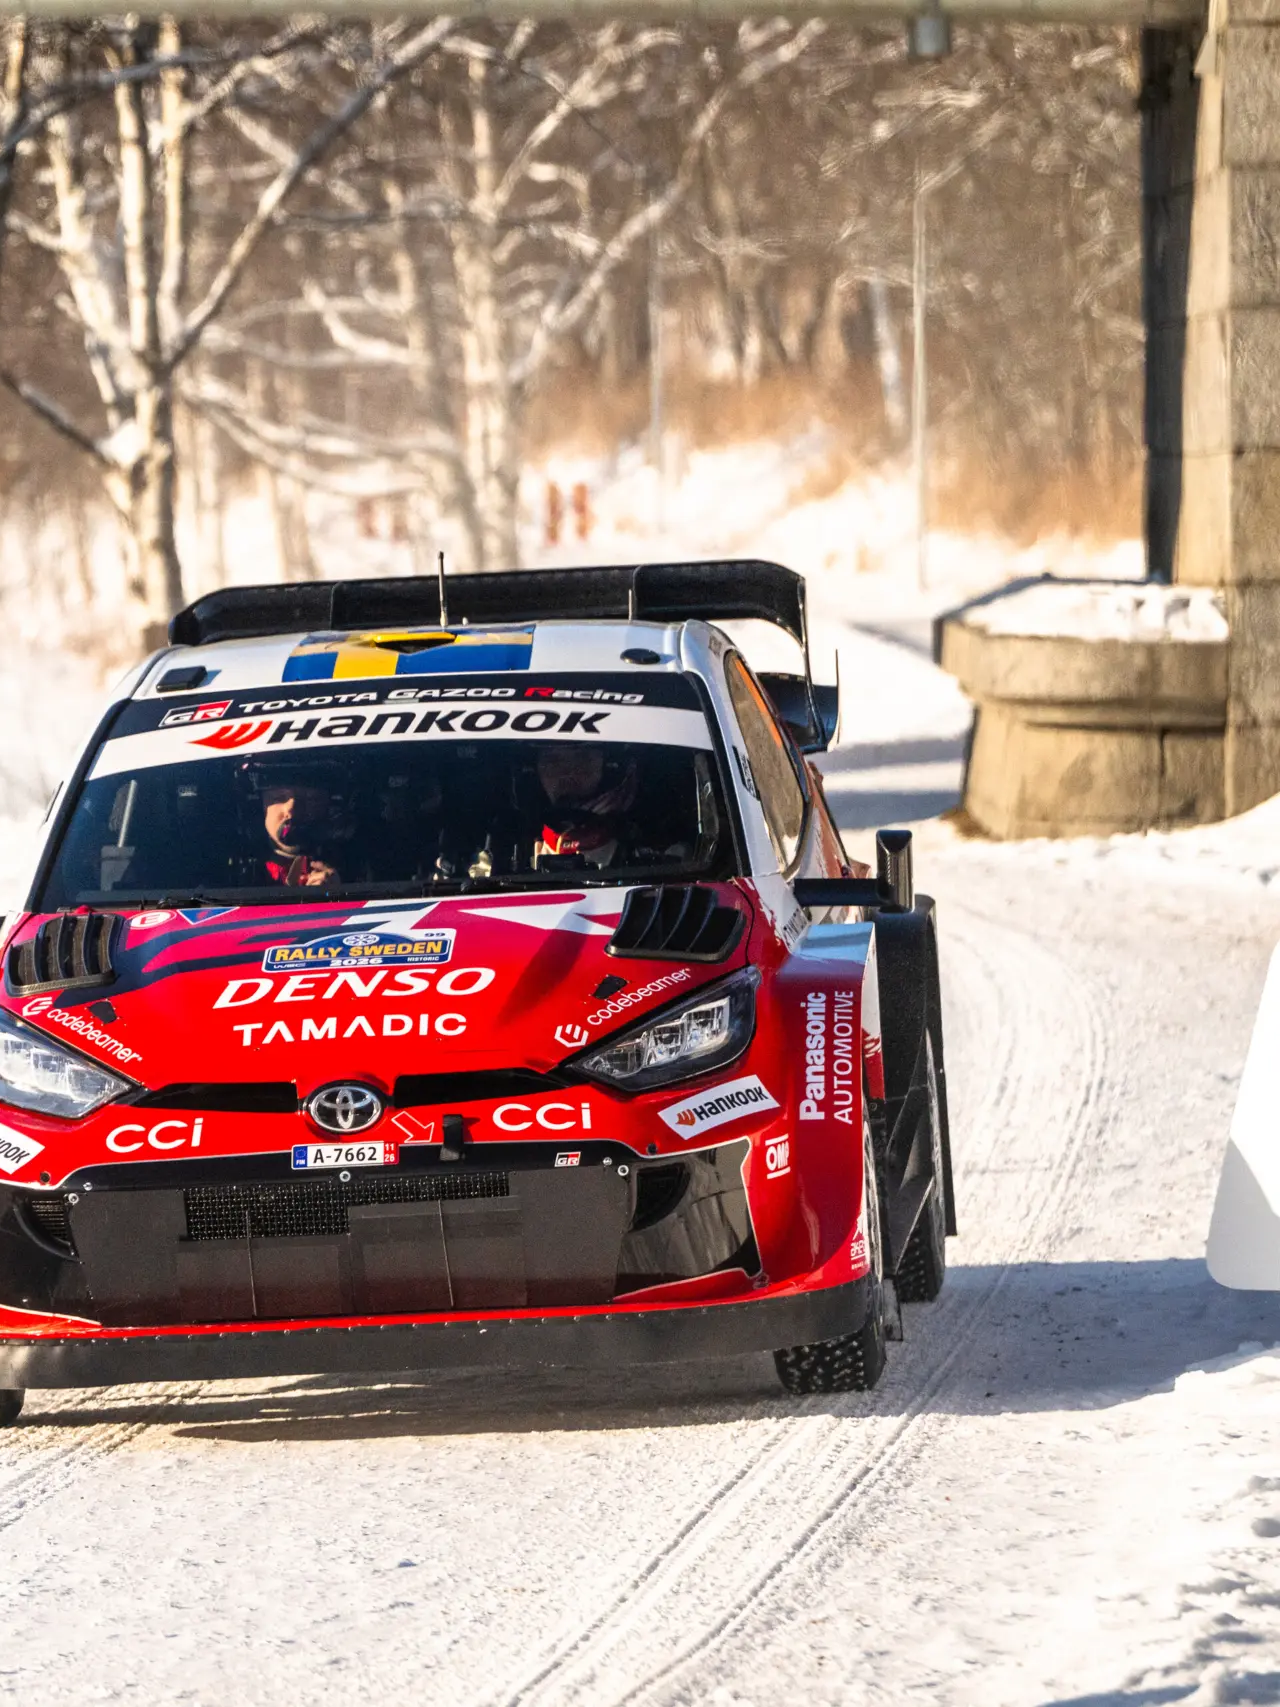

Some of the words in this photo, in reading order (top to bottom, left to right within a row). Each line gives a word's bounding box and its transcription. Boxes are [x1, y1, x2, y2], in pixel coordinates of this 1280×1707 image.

[239, 692, 378, 713] TOYOTA
[388, 688, 516, 699] GAZOO
[524, 687, 644, 704] Racing
[164, 706, 227, 723] GR
[274, 947, 344, 962] RALLY
[349, 941, 442, 957] SWEDEN
[330, 957, 383, 966] 2026
[212, 967, 496, 1009] DENSO
[587, 967, 692, 1026] codebeamer
[47, 1007, 143, 1063] codebeamer
[233, 1013, 467, 1046] TAMADIC
[799, 992, 827, 1121] Panasonic
[833, 991, 854, 1125] AUTOMOTIVE
[312, 1146, 378, 1164] A-7662
[384, 1153, 395, 1163] 26
[385, 1143, 395, 1151] 11
[766, 1140, 790, 1171] OMP
[558, 1156, 579, 1165] GR
